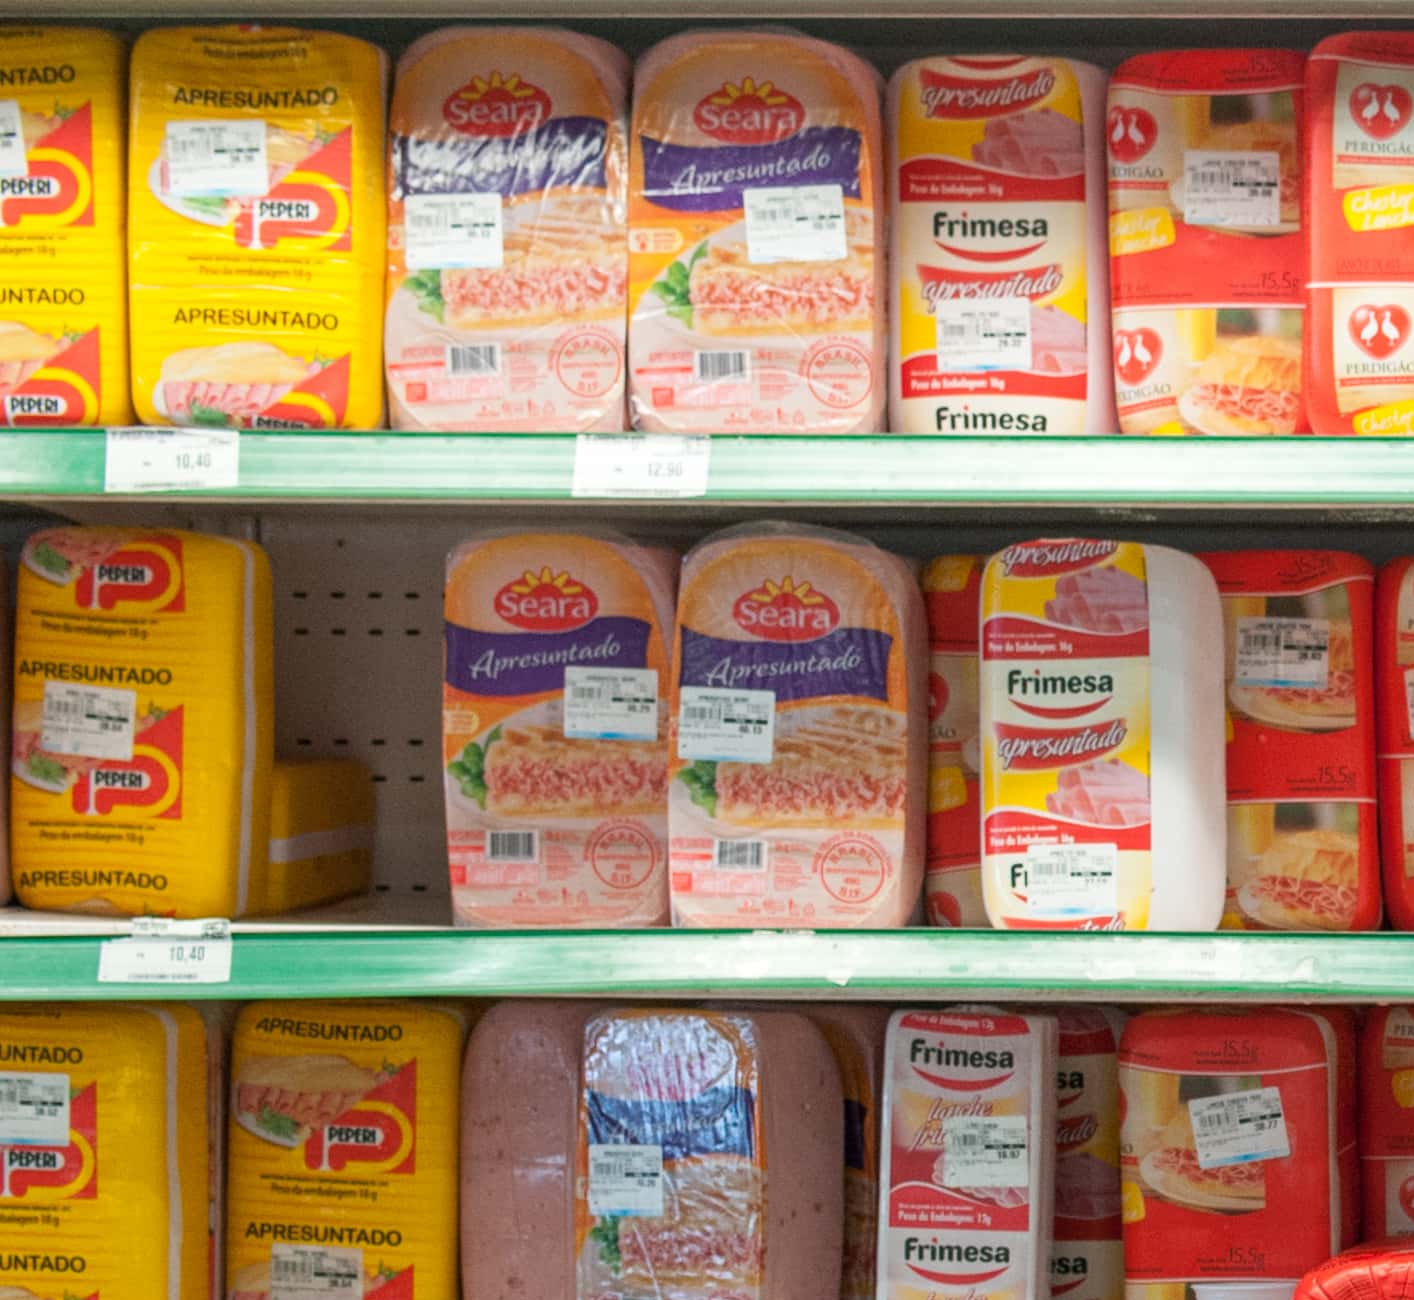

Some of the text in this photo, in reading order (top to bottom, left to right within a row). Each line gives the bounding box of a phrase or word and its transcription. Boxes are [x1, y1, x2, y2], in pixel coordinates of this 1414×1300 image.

[173, 86, 338, 109] APRESUNTADO
[920, 69, 1056, 111] apresuntado
[451, 93, 537, 126] Seara
[668, 150, 832, 197] Apresuntado
[260, 201, 310, 220] PEPERI
[933, 212, 1048, 240] Frimesa
[936, 406, 1047, 432] Frimesa
[501, 590, 590, 619] Seara
[740, 602, 830, 630] Seara
[468, 638, 620, 680] Apresuntado
[19, 661, 172, 686] APRESUNTADO
[1008, 670, 1113, 695] Frimesa
[1000, 720, 1127, 762] apresuntado
[20, 871, 168, 891] APRESUNTADO
[256, 1018, 403, 1042] APRESUNTADO
[909, 1039, 1013, 1070] Frimesa
[328, 1126, 377, 1145] PEPERI
[245, 1223, 403, 1247] APRESUNTADO
[904, 1238, 1010, 1264] Frimesa
